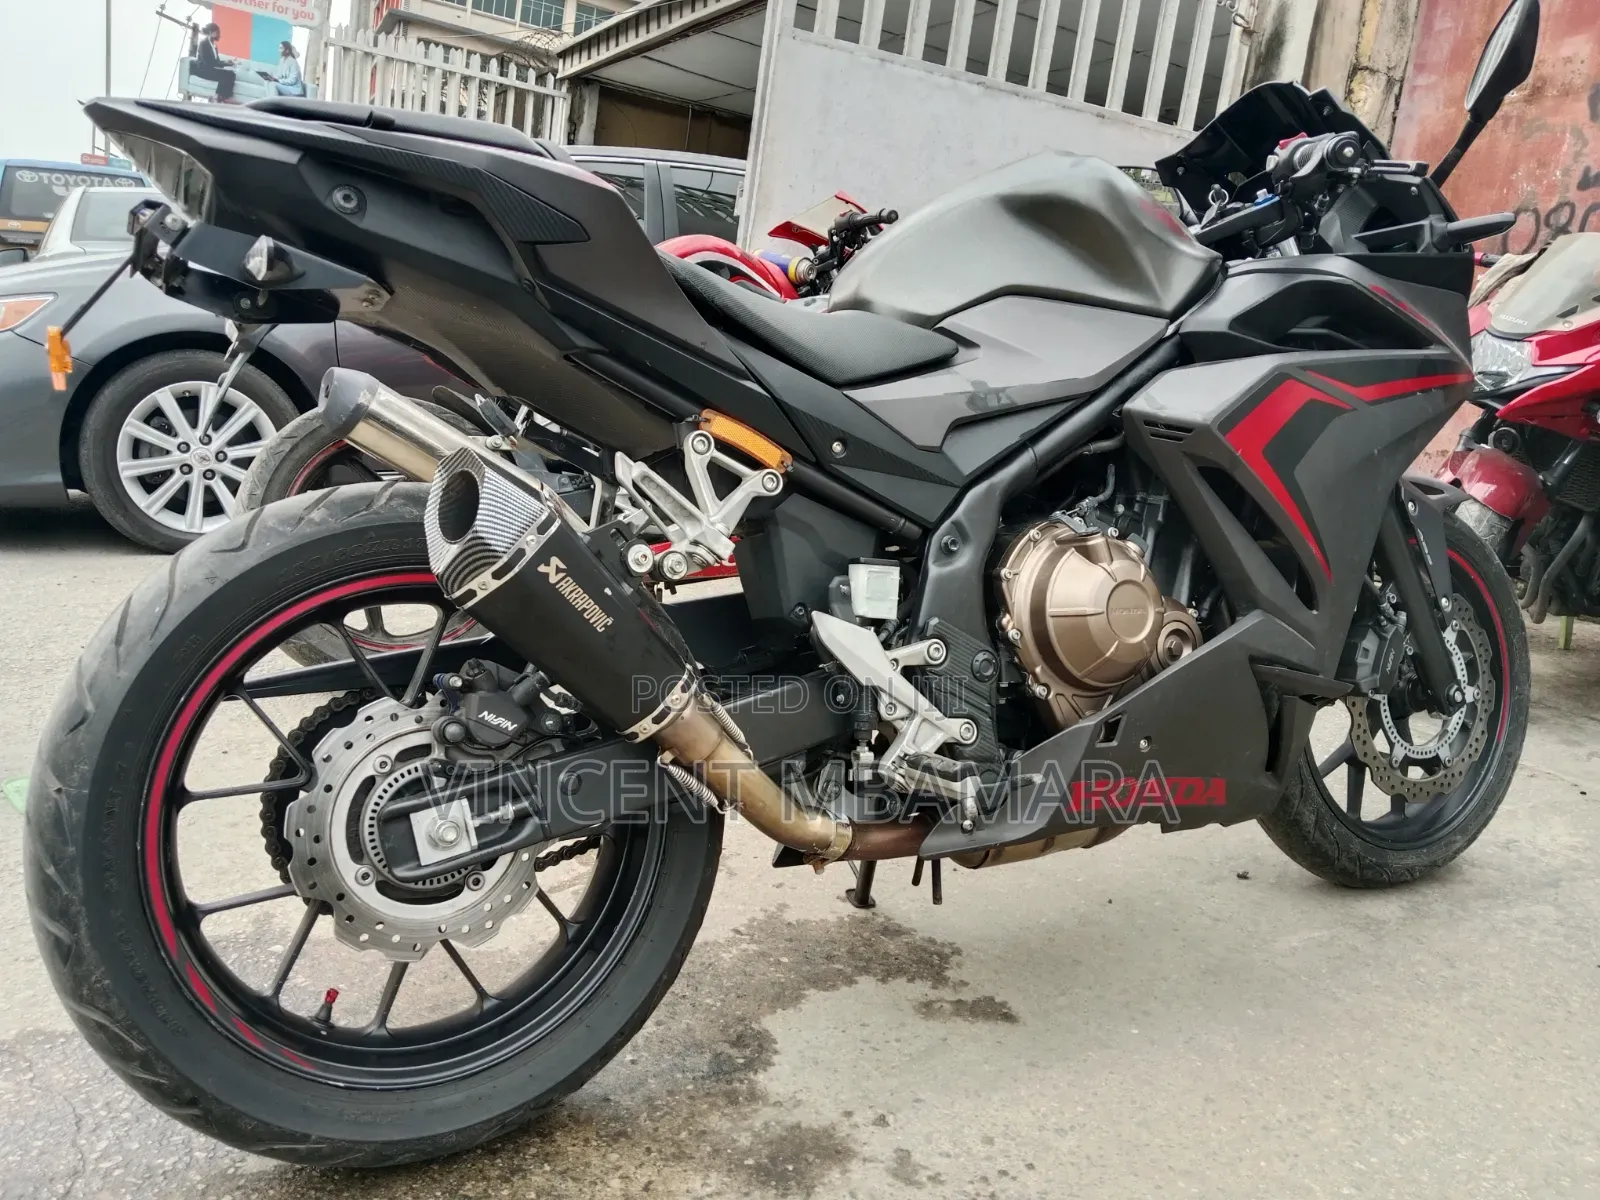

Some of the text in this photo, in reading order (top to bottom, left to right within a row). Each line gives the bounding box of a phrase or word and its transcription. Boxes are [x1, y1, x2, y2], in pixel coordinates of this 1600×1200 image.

[272, 1, 289, 15] for
[292, 8, 315, 20] you
[38, 172, 114, 187] TOYOTA
[1500, 314, 1529, 326] SUZUKI
[1065, 777, 1228, 813] HONDA
